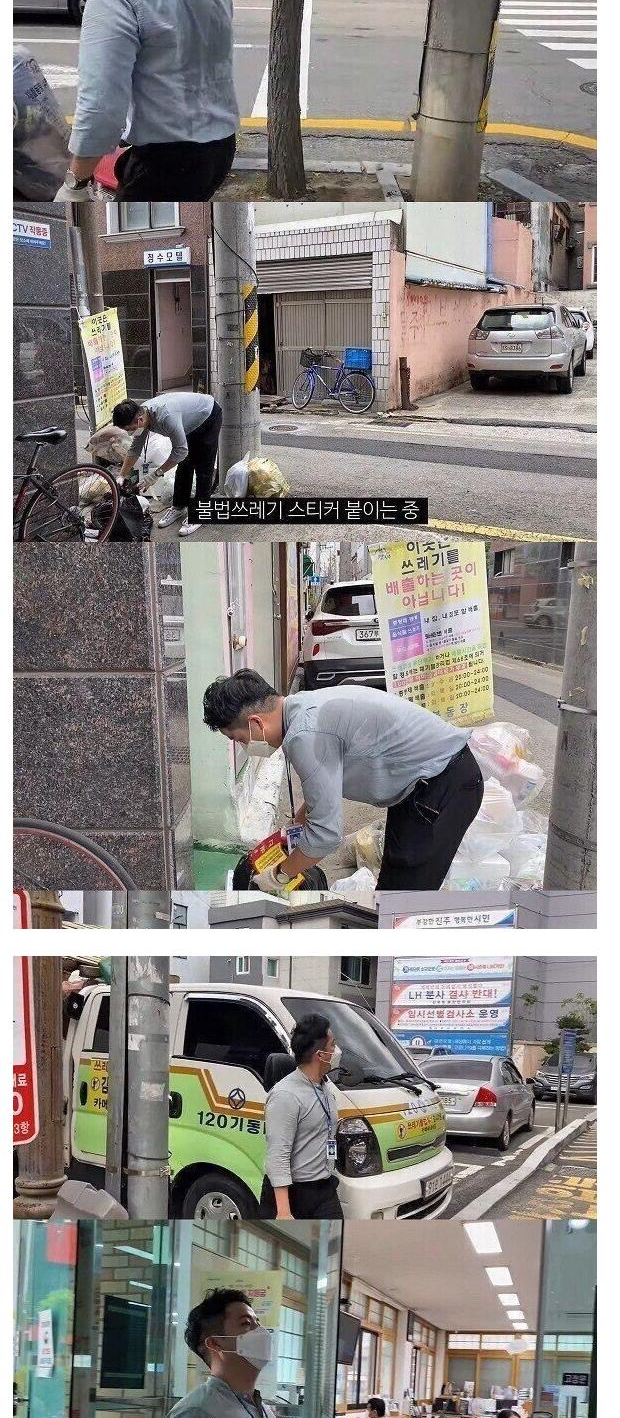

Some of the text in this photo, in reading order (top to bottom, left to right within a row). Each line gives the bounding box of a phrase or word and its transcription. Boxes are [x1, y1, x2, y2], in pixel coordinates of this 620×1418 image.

[401, 549, 459, 575] 쓰레기를
[386, 562, 477, 596] 배출하는 곳이
[402, 584, 465, 608] 아닙니다!
[409, 989, 497, 999] LH 분사 결사 반대!
[408, 1010, 499, 1019] 임시선별검사소 운영
[197, 1111, 266, 1134] 120기동
